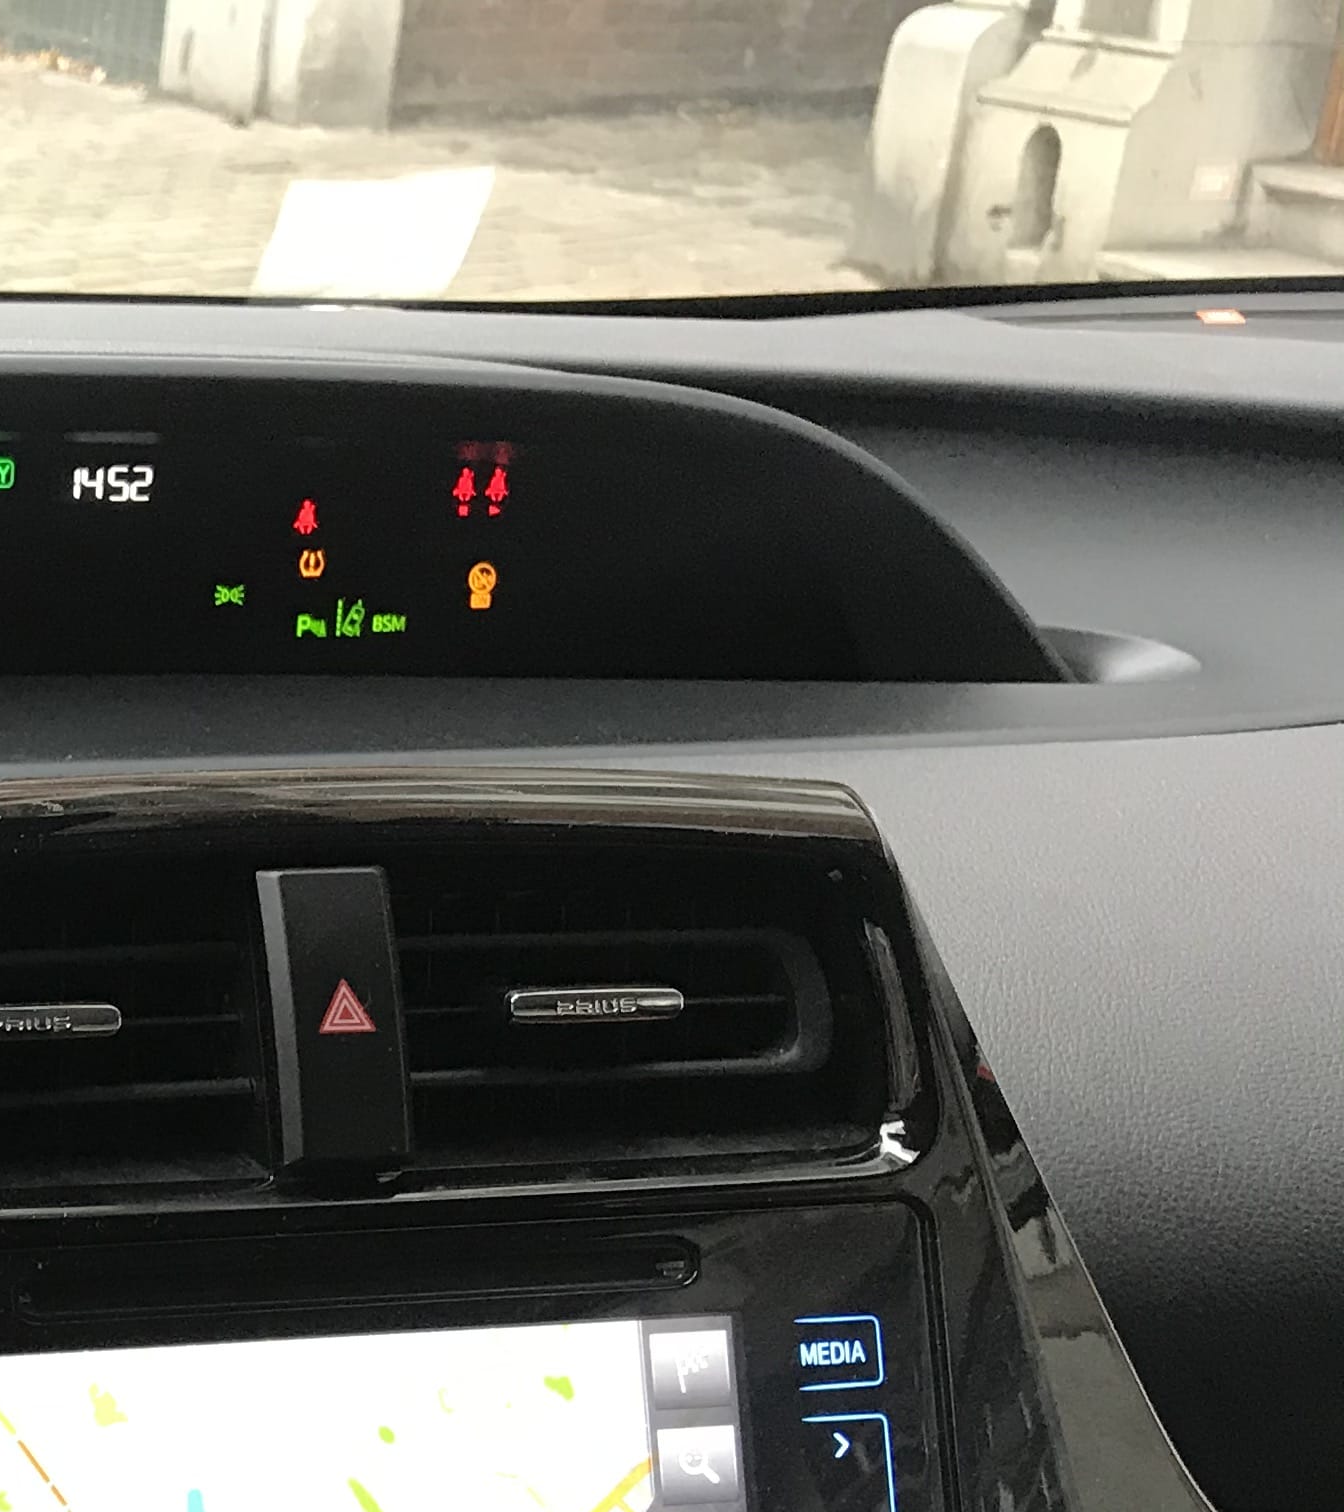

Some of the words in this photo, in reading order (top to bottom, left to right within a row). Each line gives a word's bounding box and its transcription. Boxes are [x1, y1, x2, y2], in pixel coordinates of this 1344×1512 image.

[72, 465, 154, 502] 1452
[372, 614, 406, 633] BSM
[556, 997, 638, 1016] PRIUS
[799, 1338, 867, 1367] MEDIA
